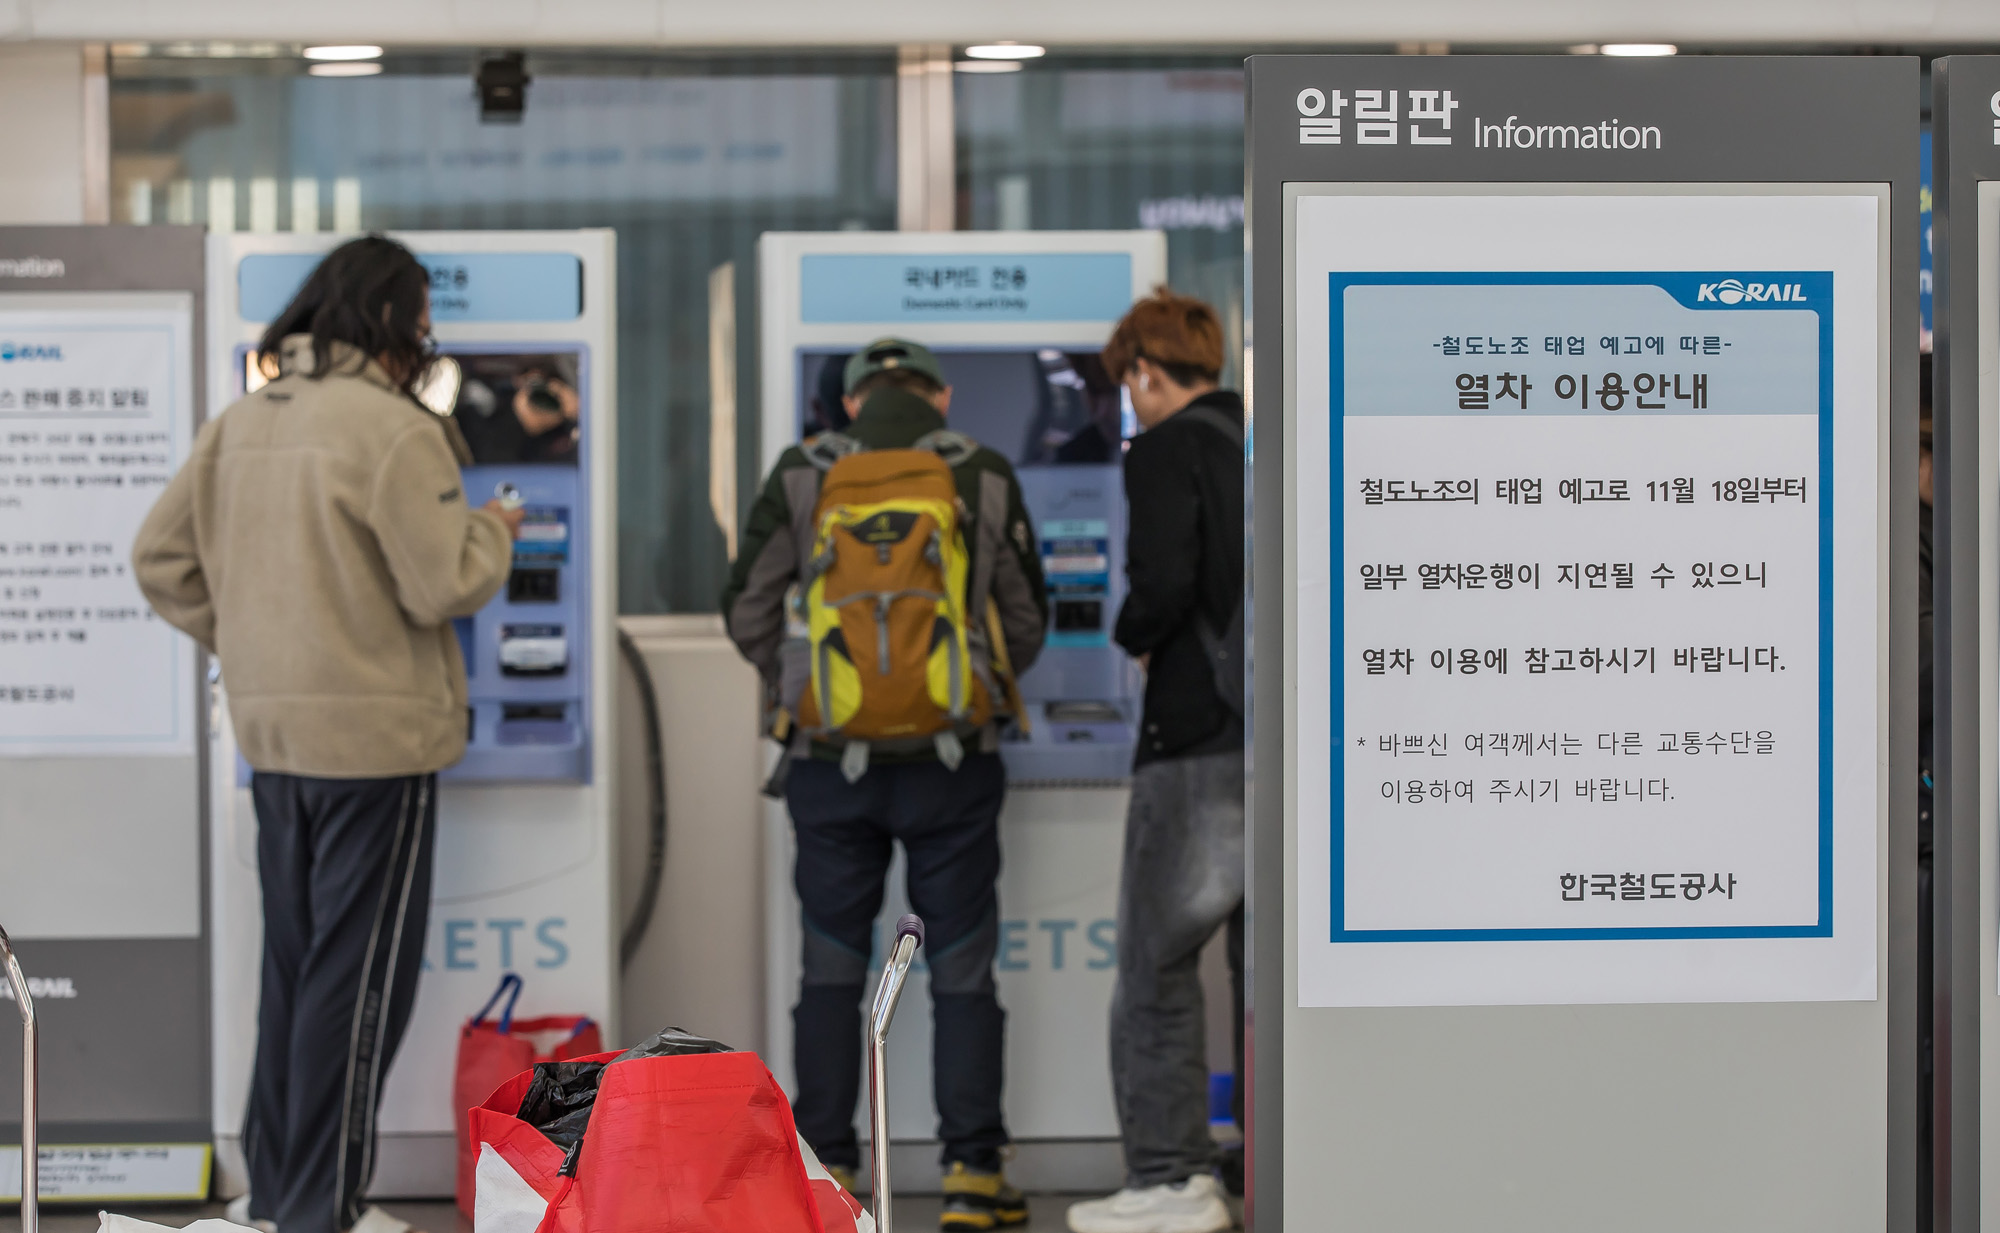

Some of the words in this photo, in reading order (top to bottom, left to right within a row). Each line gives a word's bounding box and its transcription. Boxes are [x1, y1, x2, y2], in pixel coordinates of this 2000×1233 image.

[1296, 87, 1459, 145] 알림판
[1474, 115, 1661, 150] Information
[904, 266, 979, 290] 국내카드
[991, 266, 1027, 290] 전용
[1697, 278, 1807, 305] KORAIL
[1544, 335, 1585, 356] 태업
[1599, 336, 1664, 356] 예고에
[1455, 371, 1533, 410] 열차
[1554, 372, 1708, 412] 이용안내
[1360, 478, 1479, 505] 철도노조의
[1495, 478, 1542, 505] 태업
[1558, 477, 1631, 505] 예고로
[1646, 477, 1695, 504] 11월
[1711, 476, 1806, 504] 18일부터
[1359, 563, 1408, 591] 일부
[1417, 562, 1540, 590] 열차운행이
[1557, 562, 1634, 590] 지연될
[1650, 562, 1676, 589] 수
[1691, 561, 1766, 589] 있으니
[1362, 648, 1415, 676] 열차
[1430, 647, 1508, 675] 이용에
[1524, 646, 1655, 674] 참고하시기
[1674, 646, 1786, 674] 바랍니다.
[1379, 732, 1448, 758] 바쁘신
[1464, 732, 1583, 757] 여객께서는
[1598, 731, 1643, 756] 다른
[1657, 730, 1776, 755] 교통수단을
[1381, 779, 1473, 804] 이용하여
[1489, 778, 1558, 804] 주시기
[1575, 777, 1675, 803] 바랍니다.
[1559, 872, 1737, 902] 한국철도공사
[423, 917, 569, 971] ETS
[0, 976, 78, 1000] RAIL
